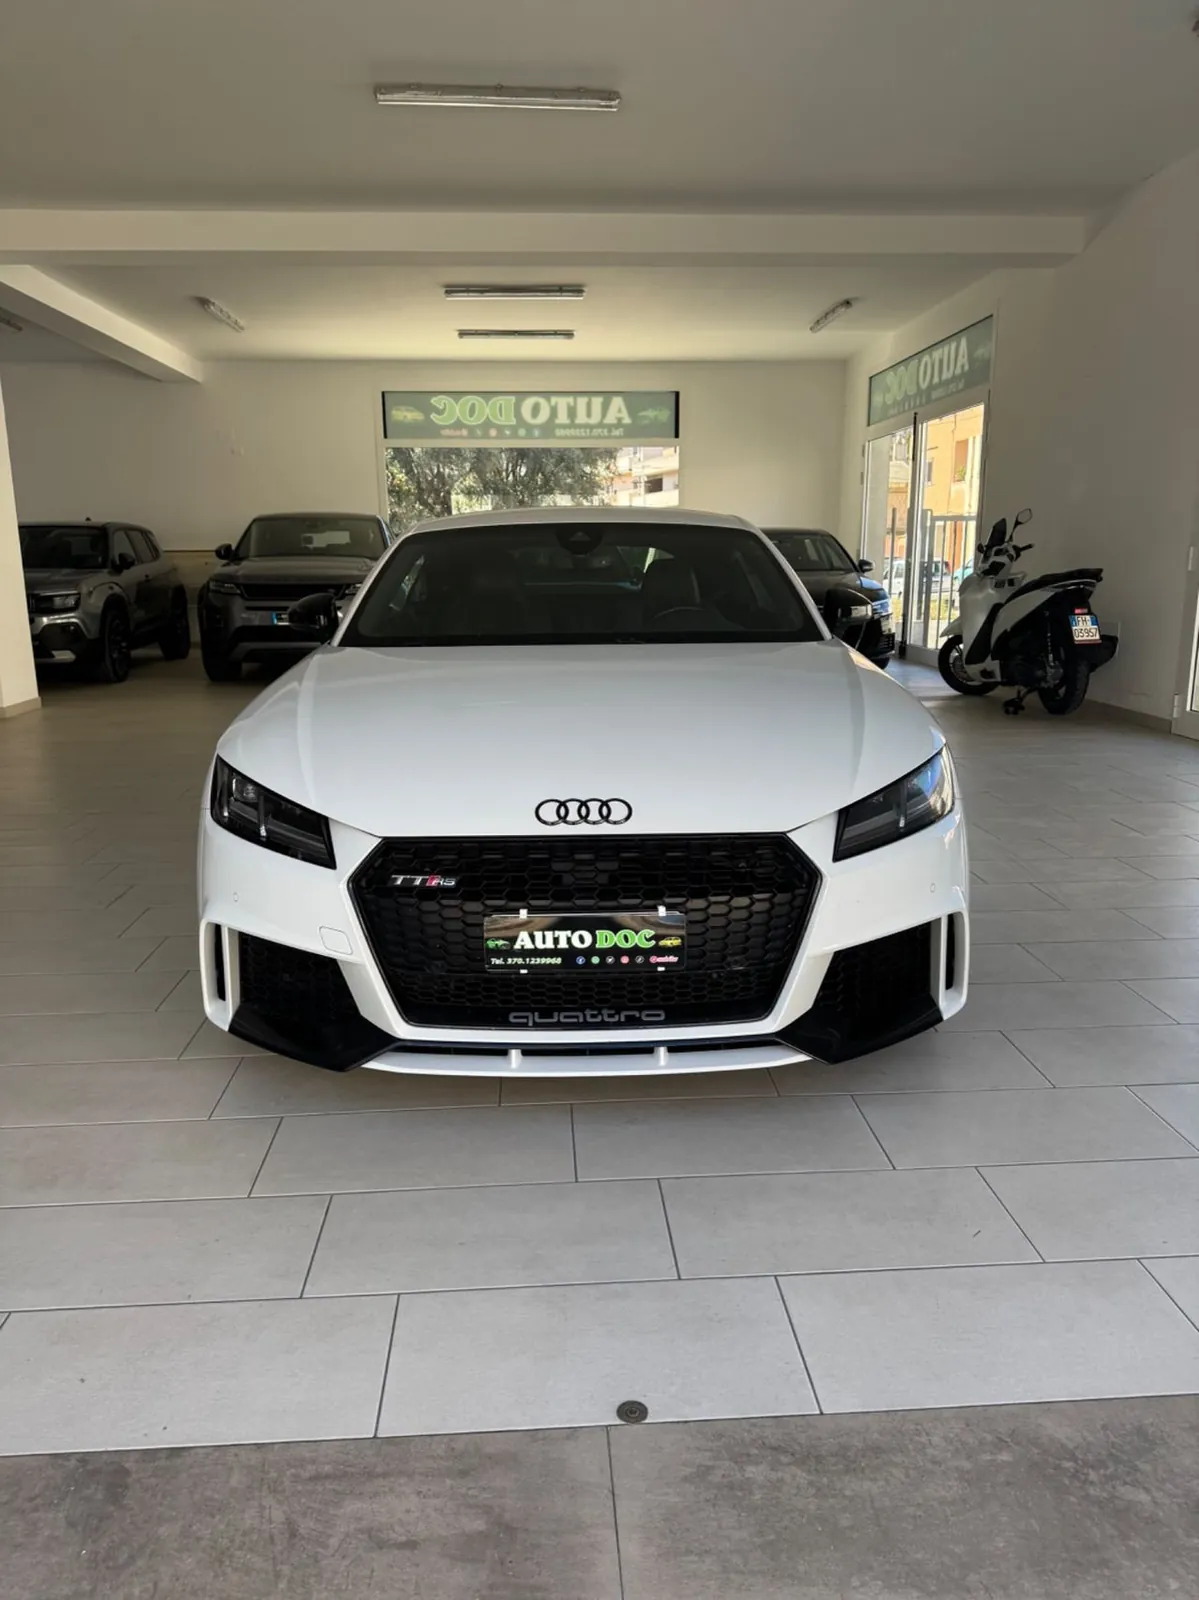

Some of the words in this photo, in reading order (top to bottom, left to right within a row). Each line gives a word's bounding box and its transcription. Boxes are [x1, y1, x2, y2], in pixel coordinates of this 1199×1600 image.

[513, 930, 593, 949] AUTO
[595, 929, 656, 949] DOC
[490, 957, 505, 965] Tel.
[508, 1008, 666, 1026] quattro
